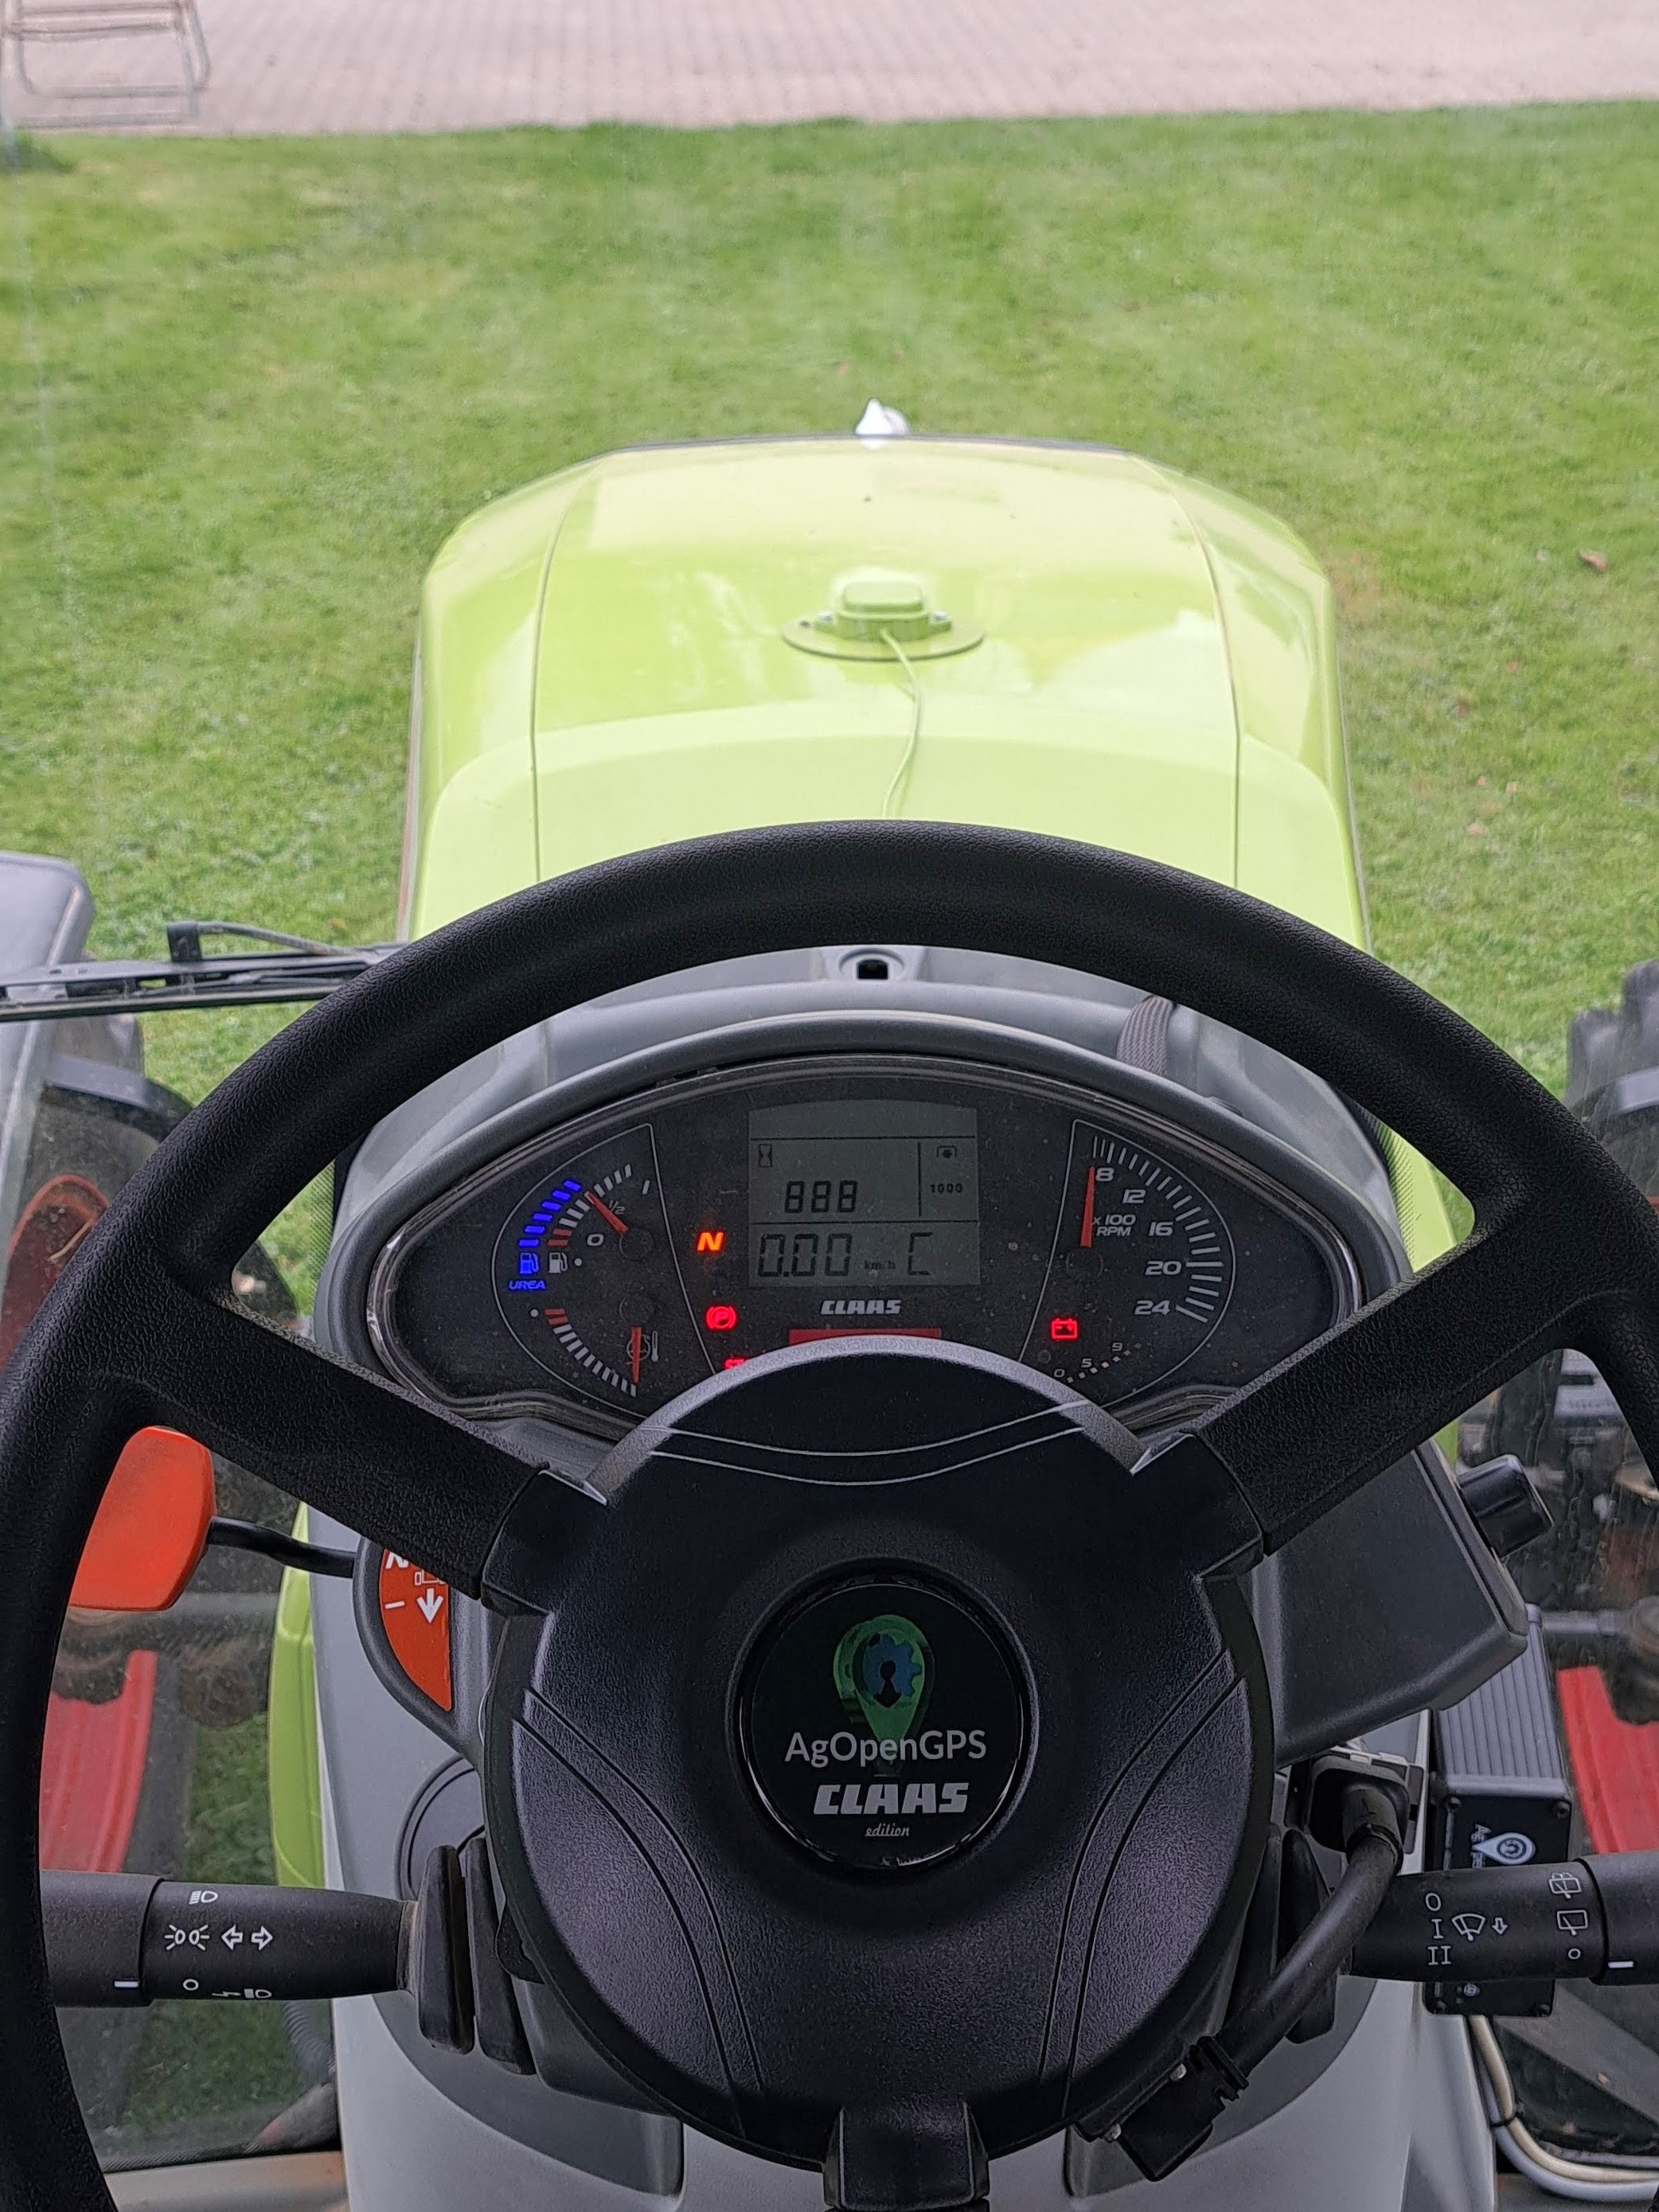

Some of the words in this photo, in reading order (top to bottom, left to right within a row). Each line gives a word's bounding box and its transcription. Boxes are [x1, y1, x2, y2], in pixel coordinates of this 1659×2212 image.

[1095, 1167, 1114, 1182] 8
[930, 1184, 962, 1193] 1000
[1122, 1188, 1146, 1204] 12
[784, 1180, 858, 1213] 888
[1105, 1214, 1136, 1225] 100
[1096, 1226, 1131, 1236] RPM
[1149, 1221, 1173, 1236] 16
[758, 1234, 852, 1277] 0.00
[1145, 1261, 1182, 1275] 20
[509, 1280, 546, 1290] UREA
[821, 1299, 902, 1315] CLAAS
[1134, 1301, 1170, 1315] 24
[784, 1730, 986, 1768] AgOpenGPS
[813, 1782, 970, 1815] CLAAS
[864, 1823, 911, 1837] edition
